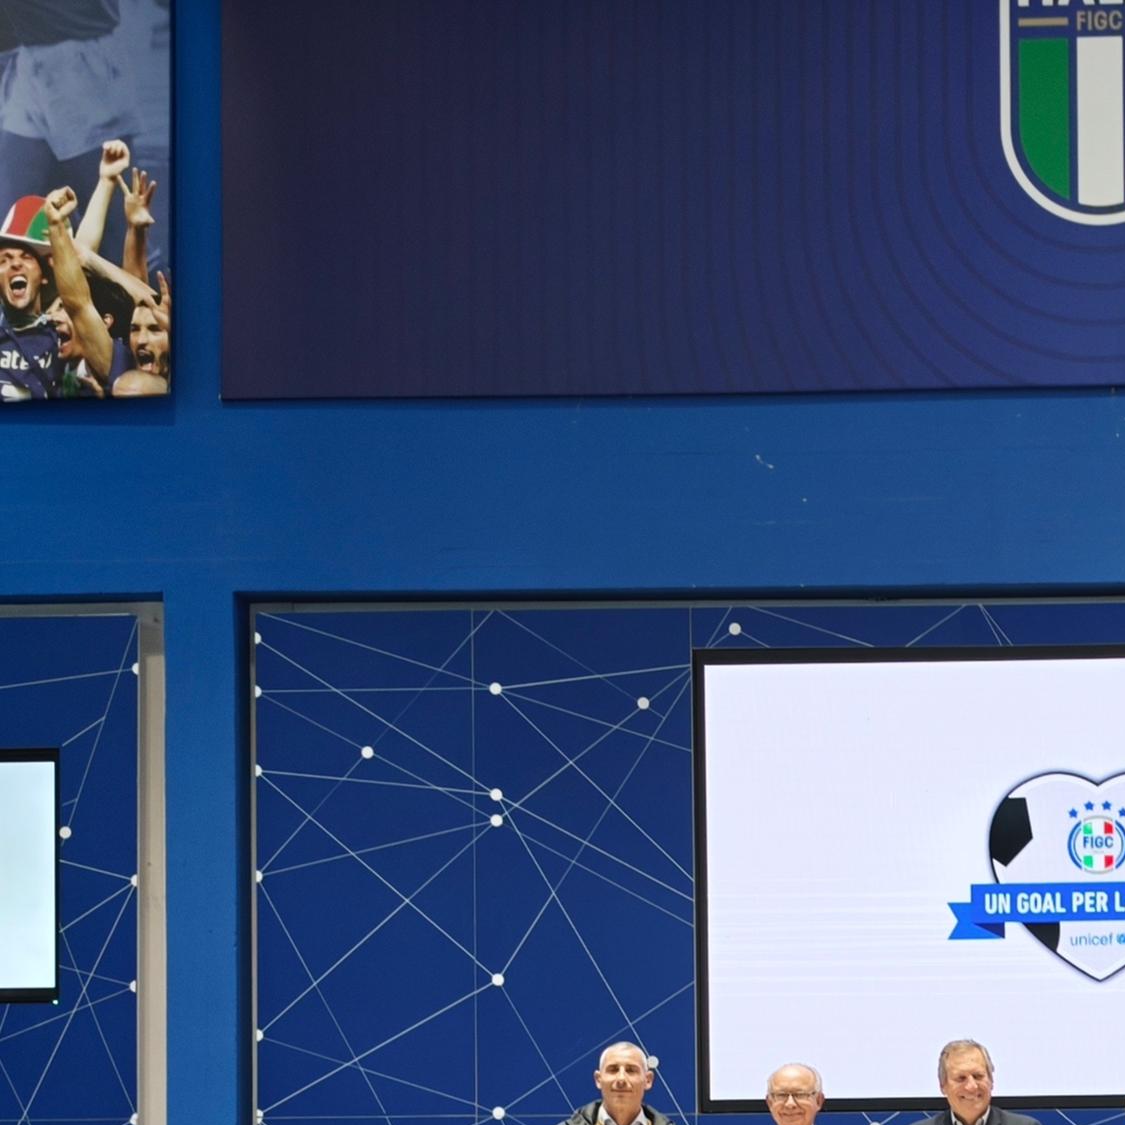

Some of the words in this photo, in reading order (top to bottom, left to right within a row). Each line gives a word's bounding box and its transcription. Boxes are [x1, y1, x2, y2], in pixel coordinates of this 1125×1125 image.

[1076, 10, 1122, 31] FIGC
[1083, 835, 1114, 849] FIGC
[984, 892, 1011, 914] UN
[1016, 892, 1066, 913] GOAL
[1072, 891, 1109, 913] PER
[1070, 932, 1113, 946] unicef
